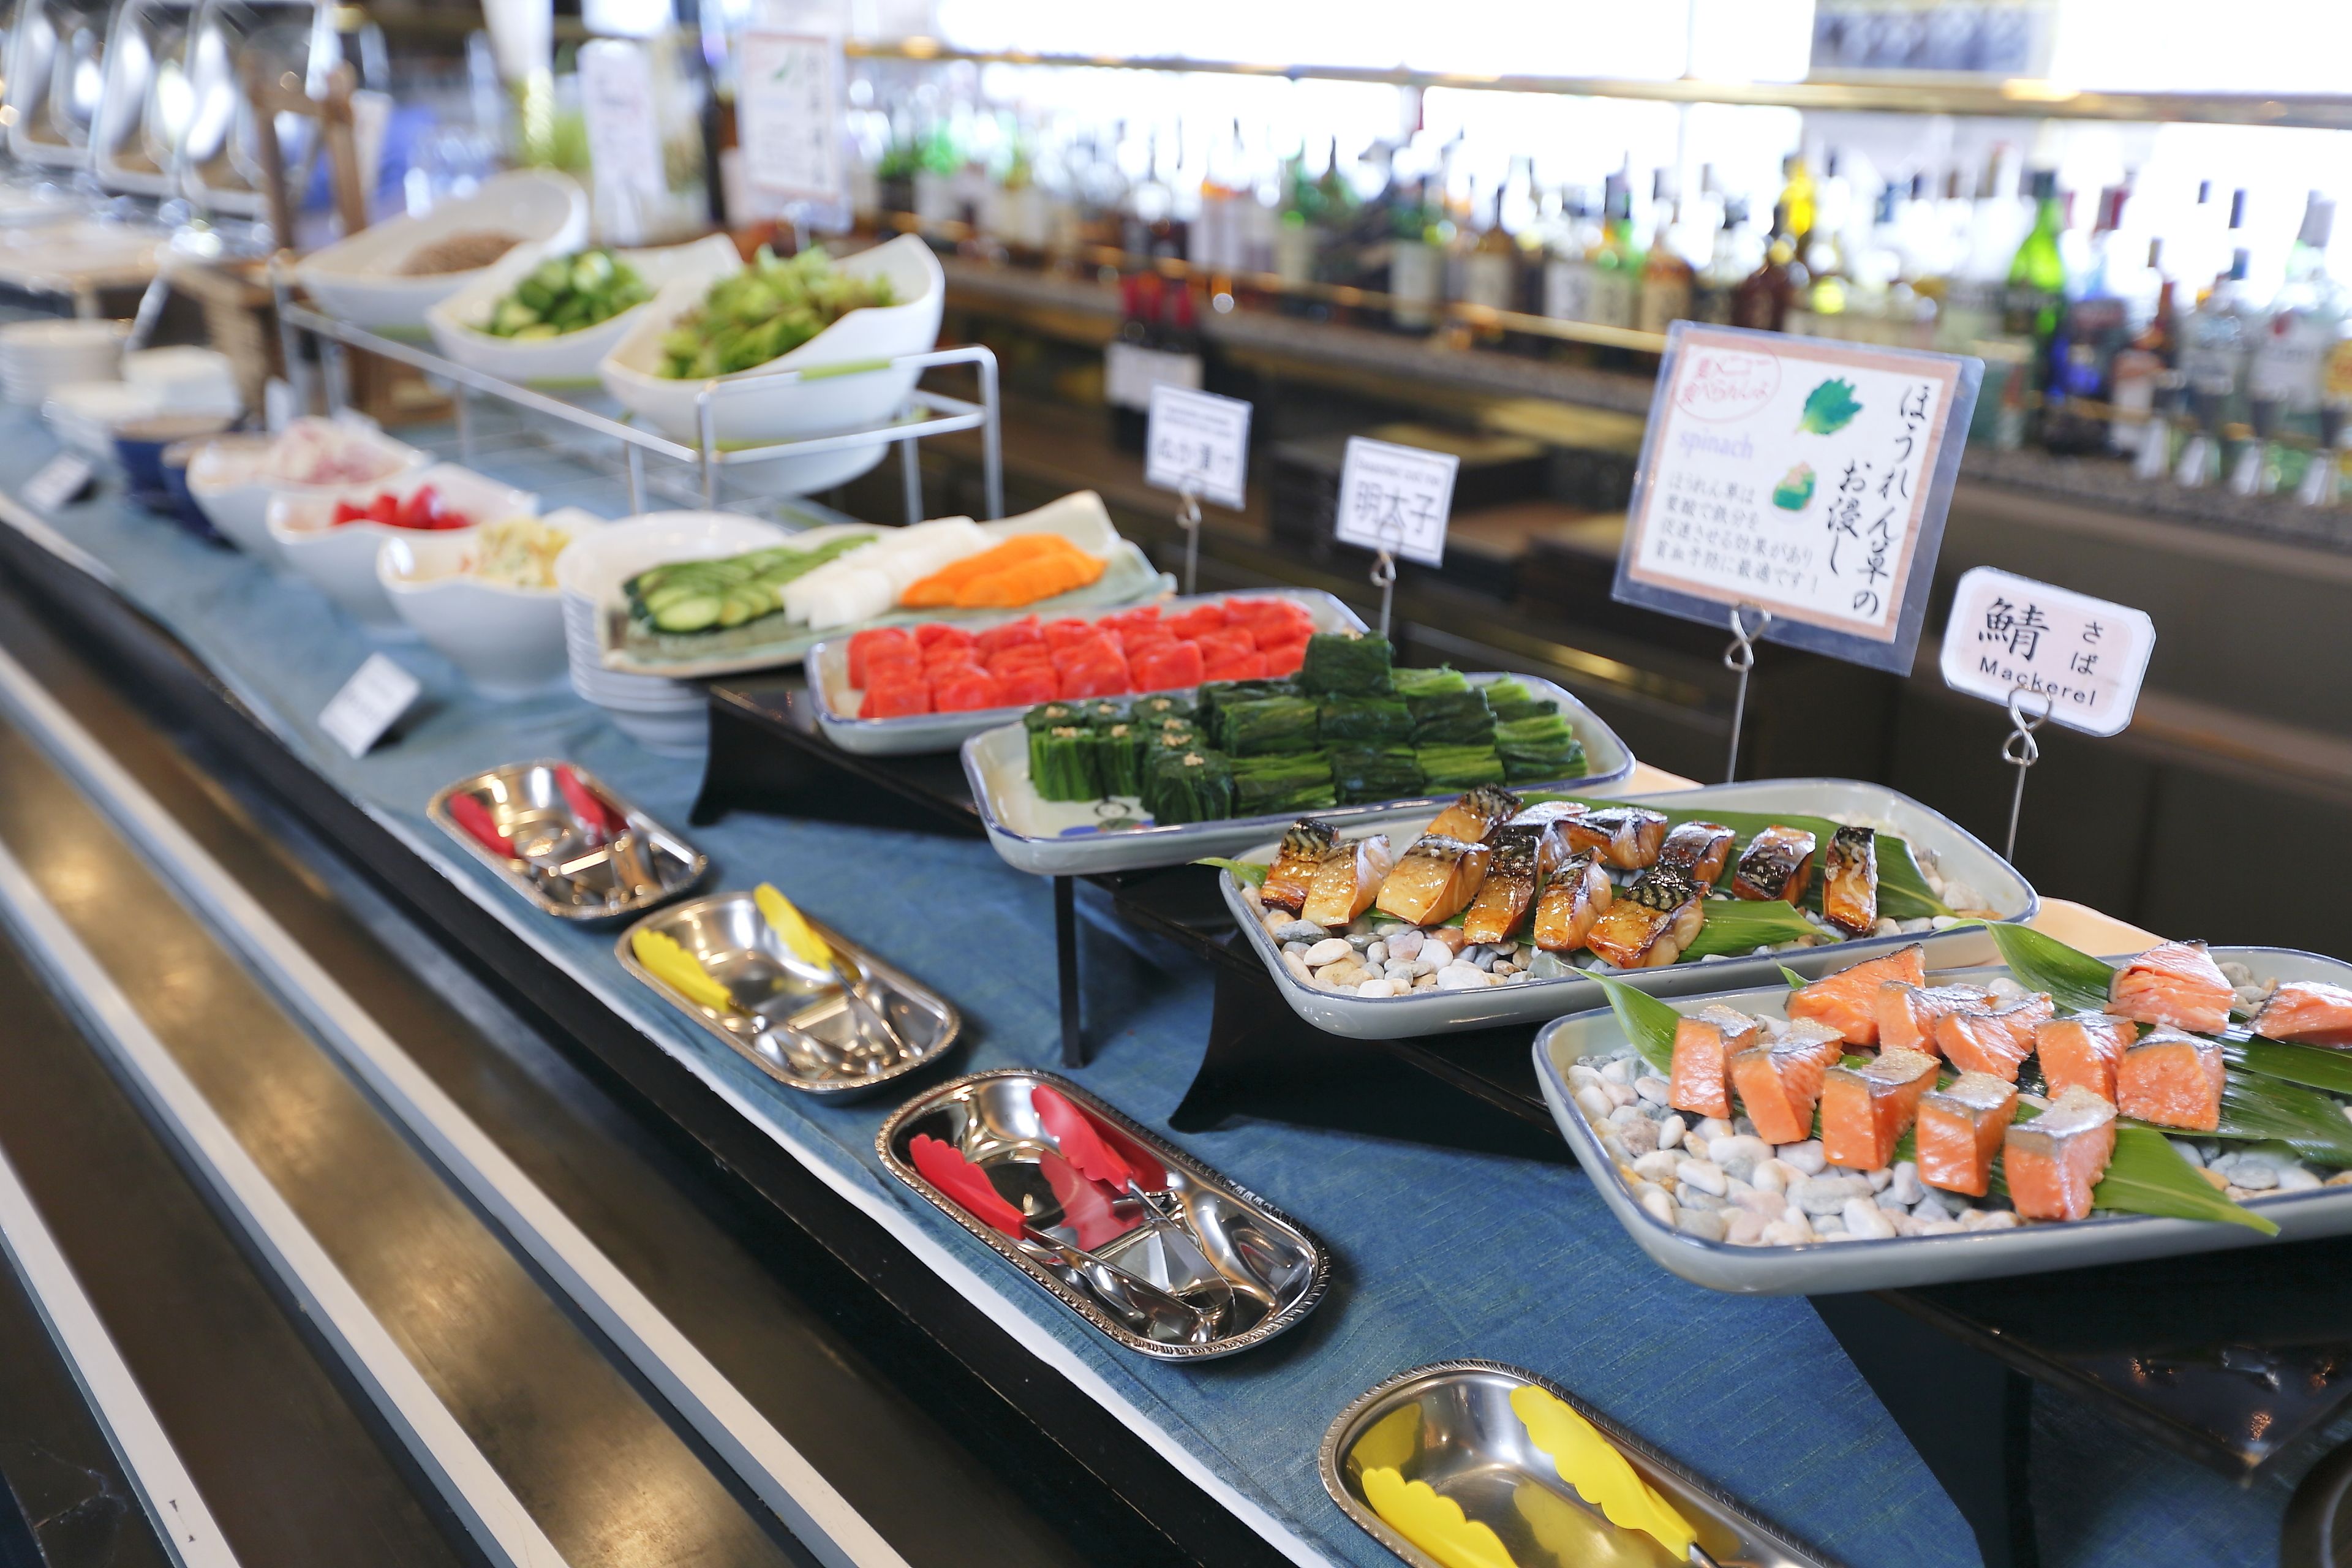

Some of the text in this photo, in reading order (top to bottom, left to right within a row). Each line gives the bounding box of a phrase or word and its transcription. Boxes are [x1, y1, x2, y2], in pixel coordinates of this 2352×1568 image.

[1679, 428, 1754, 460] spinach
[1354, 480, 1439, 535] 明太子
[1828, 459, 1872, 575] お浸し
[1853, 385, 1930, 617] ほうれん草の
[1978, 597, 2051, 662] 鯖
[2070, 620, 2105, 676] さば
[1980, 655, 2097, 707] Mackerel
